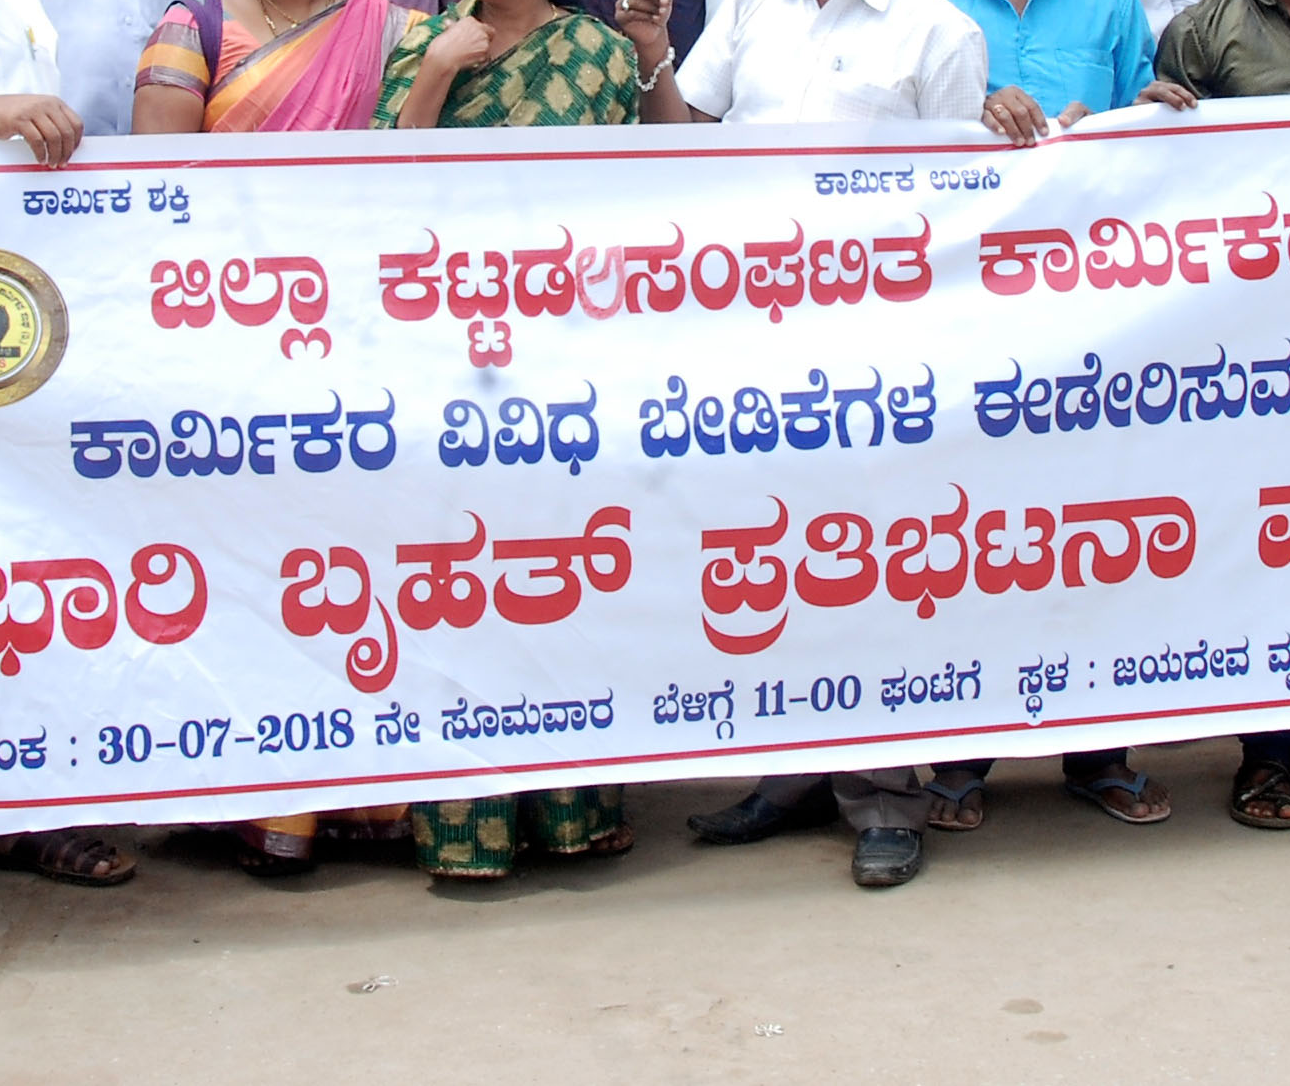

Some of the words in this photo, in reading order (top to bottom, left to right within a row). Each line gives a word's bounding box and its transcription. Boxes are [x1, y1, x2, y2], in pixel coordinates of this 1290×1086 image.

[22, 182, 132, 216] ಕಾರ್ಮಿಕ
[147, 181, 191, 224] ಶಕ್ತಿ
[814, 166, 914, 195] ಕಾರ್ಮಿಕ
[931, 170, 1001, 190] ಉಳಿಸಿ
[151, 256, 332, 359] ಜಿಲ್ಲಾ
[379, 228, 576, 368] ಕಟ್ಟಡ
[70, 390, 397, 480] ಕಾರ್ಮಿಕರ
[438, 382, 600, 477] ವಿವಿಧ
[639, 365, 937, 459] ಬೇಡಿಕೆಗಳ
[280, 505, 633, 694] ಬೃಹತ್
[701, 484, 1197, 656] ಪ್ರತಿಭಟನಾ
[98, 708, 355, 766] 30-07-2018
[374, 701, 421, 746] ನೇ
[441, 688, 614, 742] ಸೋಮವಾರ
[652, 679, 735, 741] ಬೆಳಿಗ್ಗೆ
[754, 674, 862, 718] 11-00
[880, 659, 982, 714] ಘಂಟೆಗೆ
[1018, 652, 1070, 719] ಸ್ಥಳ
[1113, 636, 1251, 687] ಜಯದೇವ
